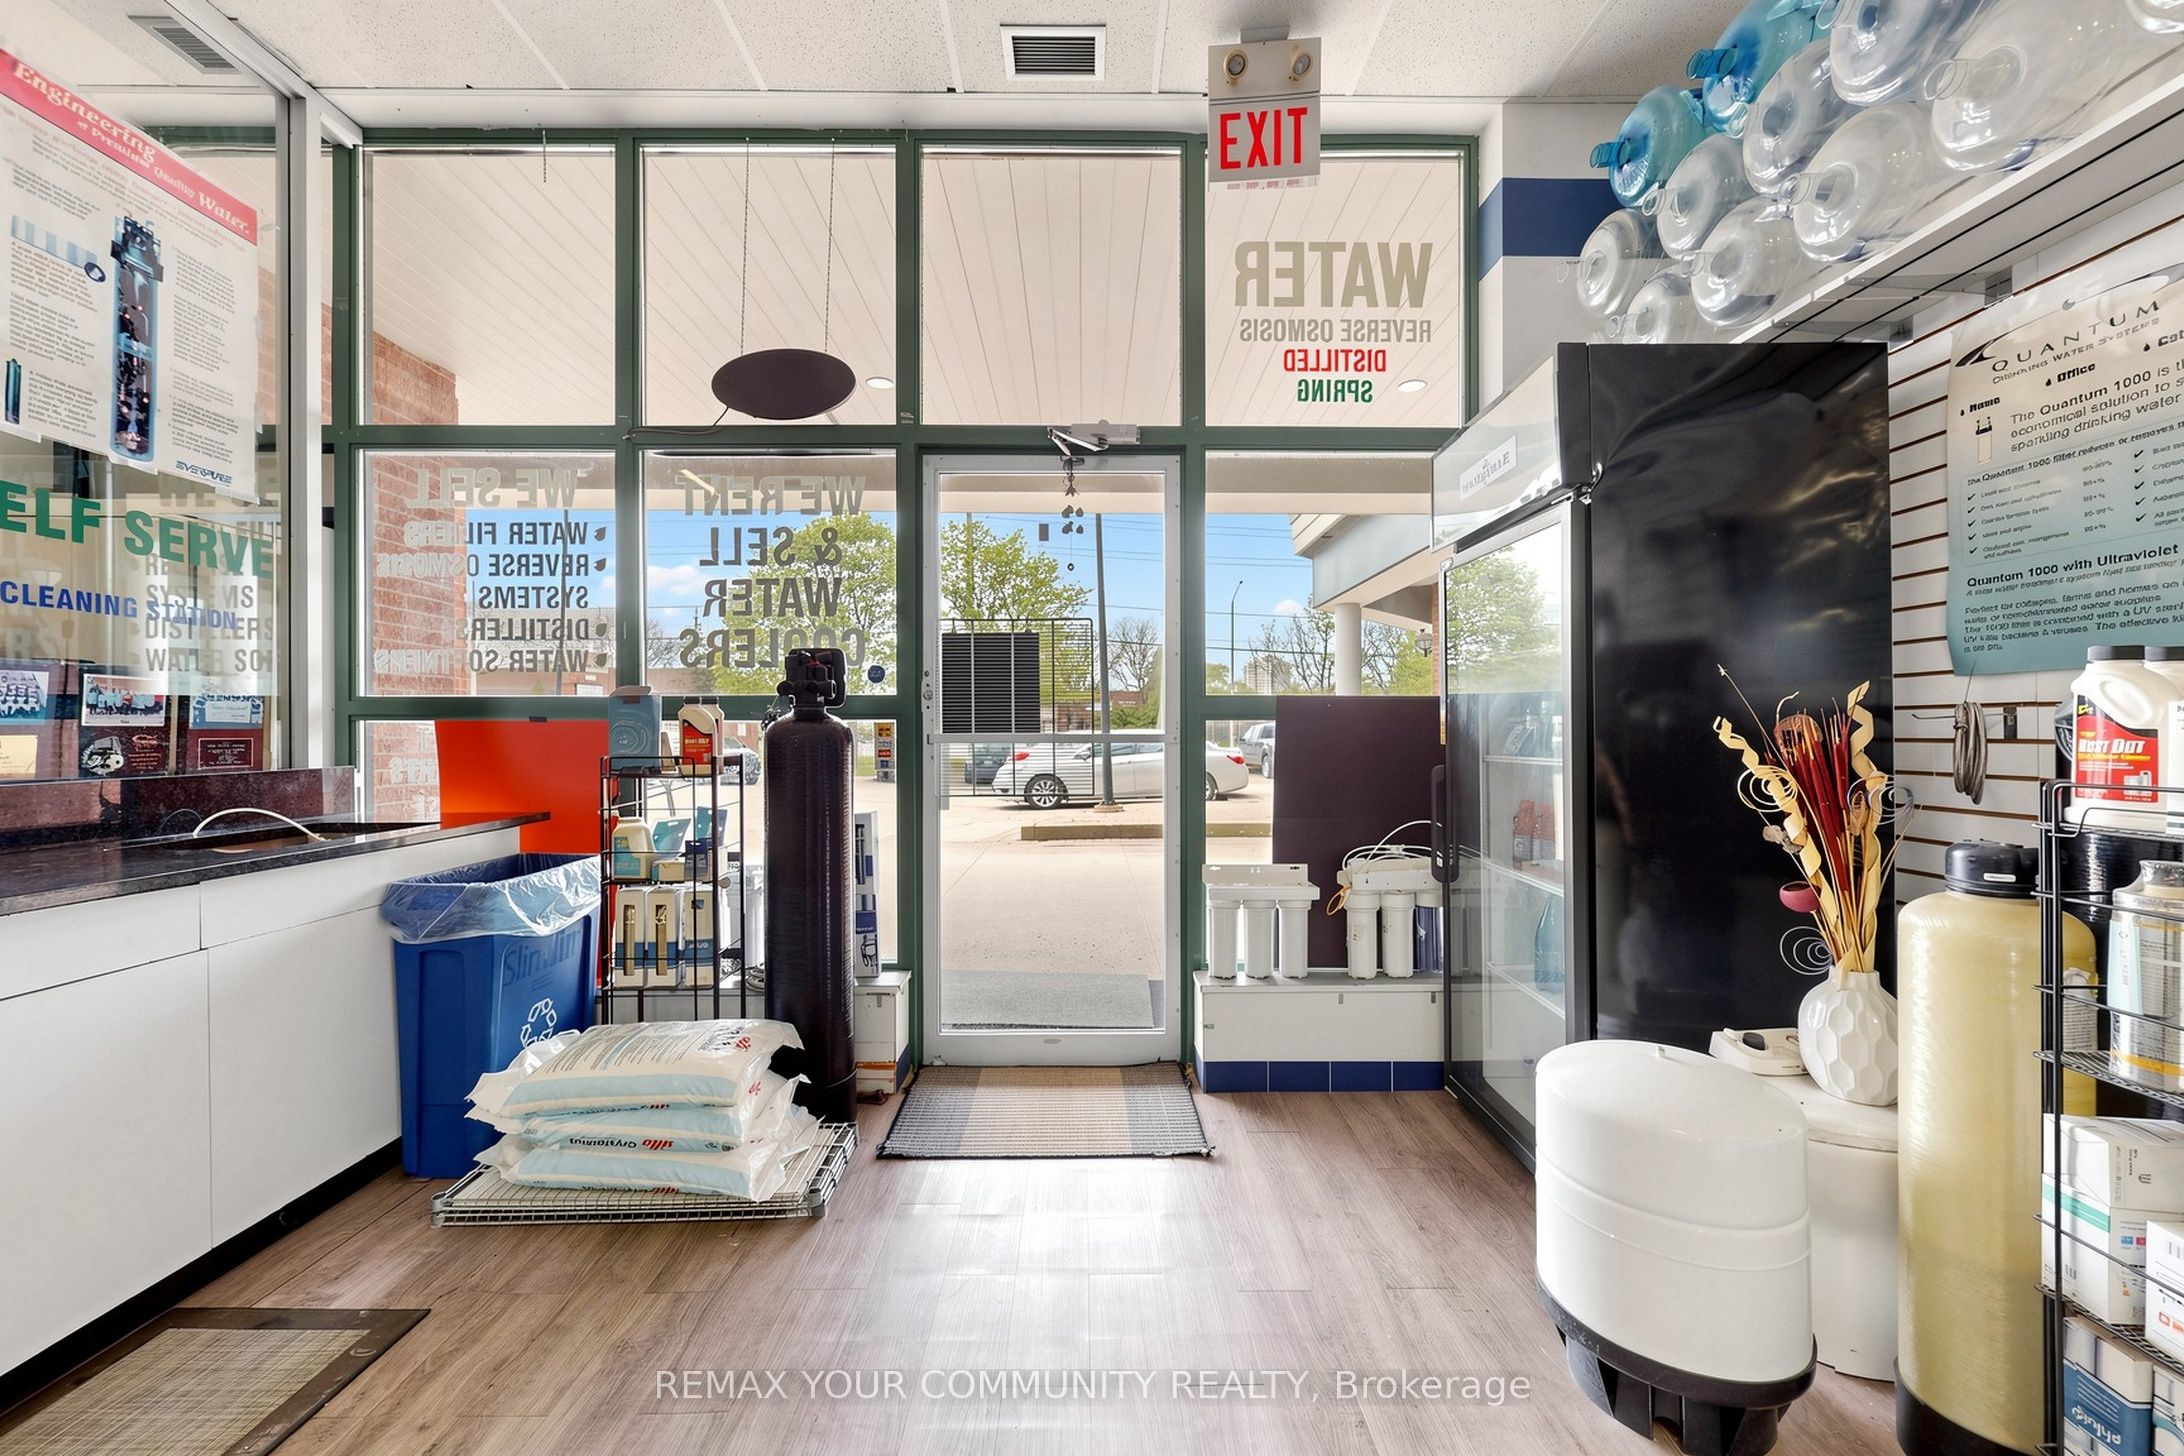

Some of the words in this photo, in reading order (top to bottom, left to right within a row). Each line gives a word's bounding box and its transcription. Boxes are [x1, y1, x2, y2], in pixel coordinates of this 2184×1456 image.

[14, 62, 156, 164] Engineering
[1219, 107, 1308, 170] EXIT
[1992, 300, 2160, 372] QUANTUM
[2010, 411, 2035, 425] The
[2040, 387, 2108, 416] Quantum
[2114, 371, 2151, 392] 1000
[2157, 366, 2170, 377] is
[2057, 363, 2096, 383] Office
[2011, 406, 2087, 438] economical
[2091, 388, 2149, 413] solution
[2155, 382, 2170, 394] to
[2011, 426, 2070, 453] sparkling
[2074, 409, 2131, 433] drinking
[2136, 393, 2182, 414] water
[124, 510, 274, 580] SERVE
[2028, 564, 2059, 577] 1000
[2063, 559, 2092, 572] with
[2097, 544, 2179, 567] Ultraviolet
[0, 580, 137, 617] CLEANING
[146, 601, 237, 630] STATION
[2133, 605, 2152, 615] UV
